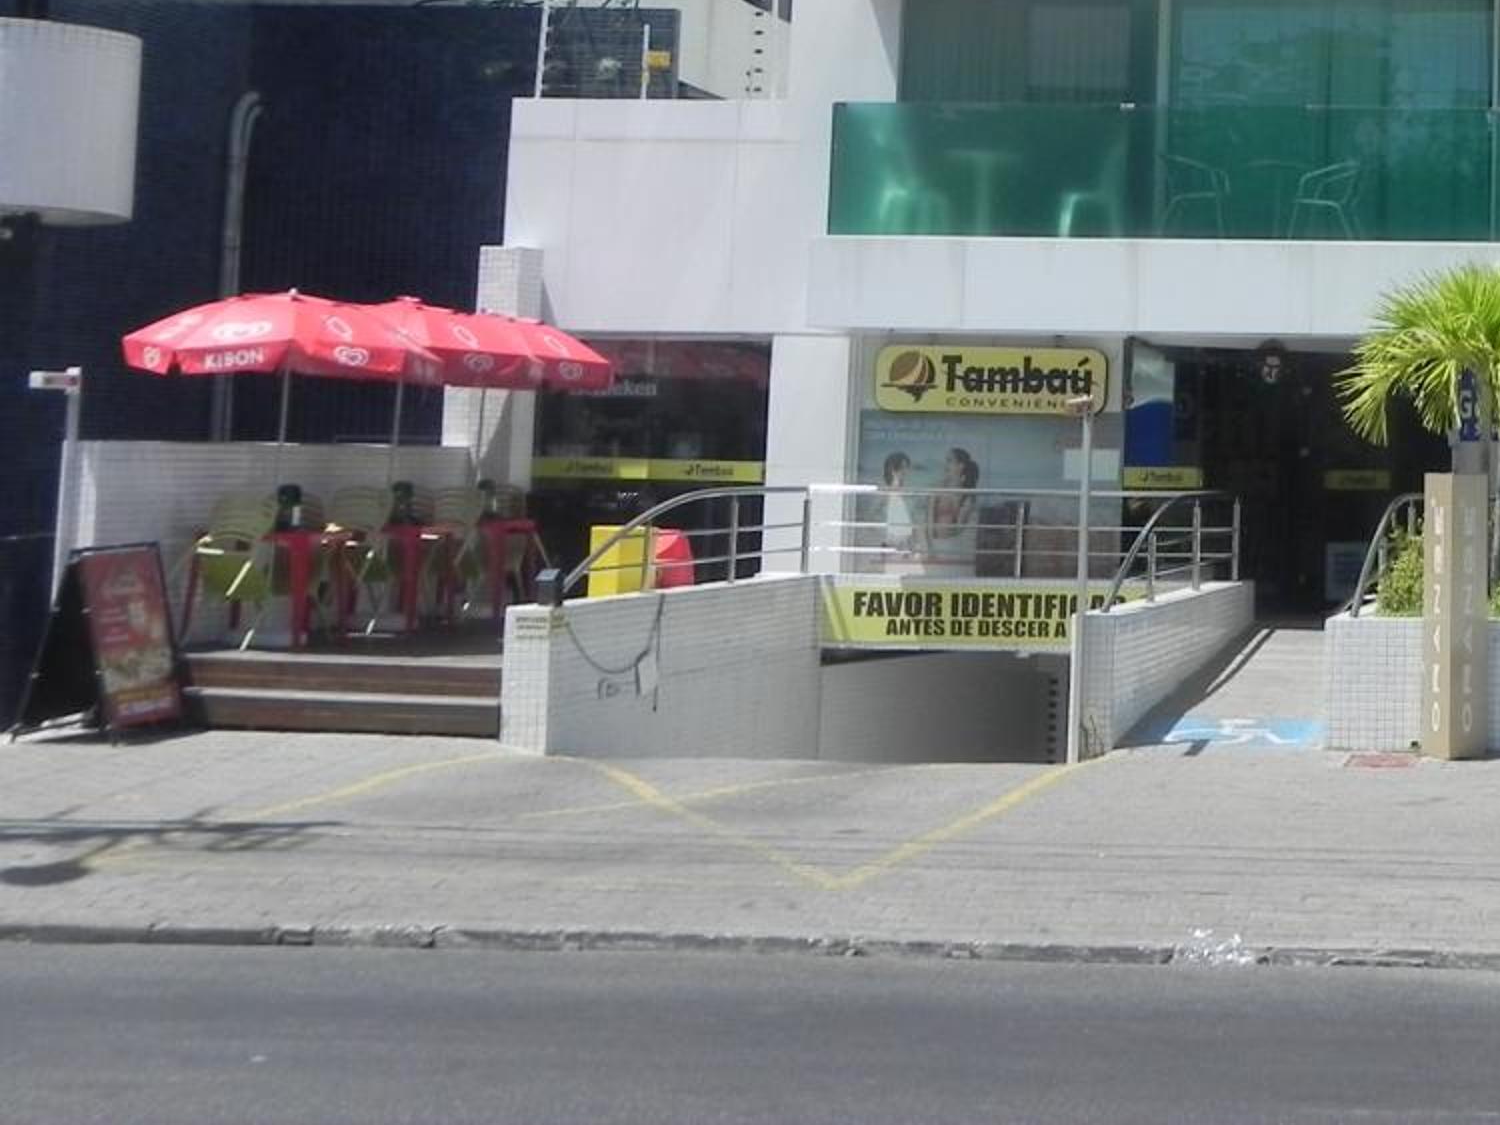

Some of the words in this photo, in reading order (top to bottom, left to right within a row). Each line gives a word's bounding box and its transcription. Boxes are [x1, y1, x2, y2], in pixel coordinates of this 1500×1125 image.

[941, 354, 1092, 394] Tambaú
[853, 591, 943, 618] FAVOR
[886, 618, 945, 636] ANTES
[951, 620, 974, 636] DE
[978, 621, 1050, 637] DESCER
[1053, 621, 1067, 638] A
